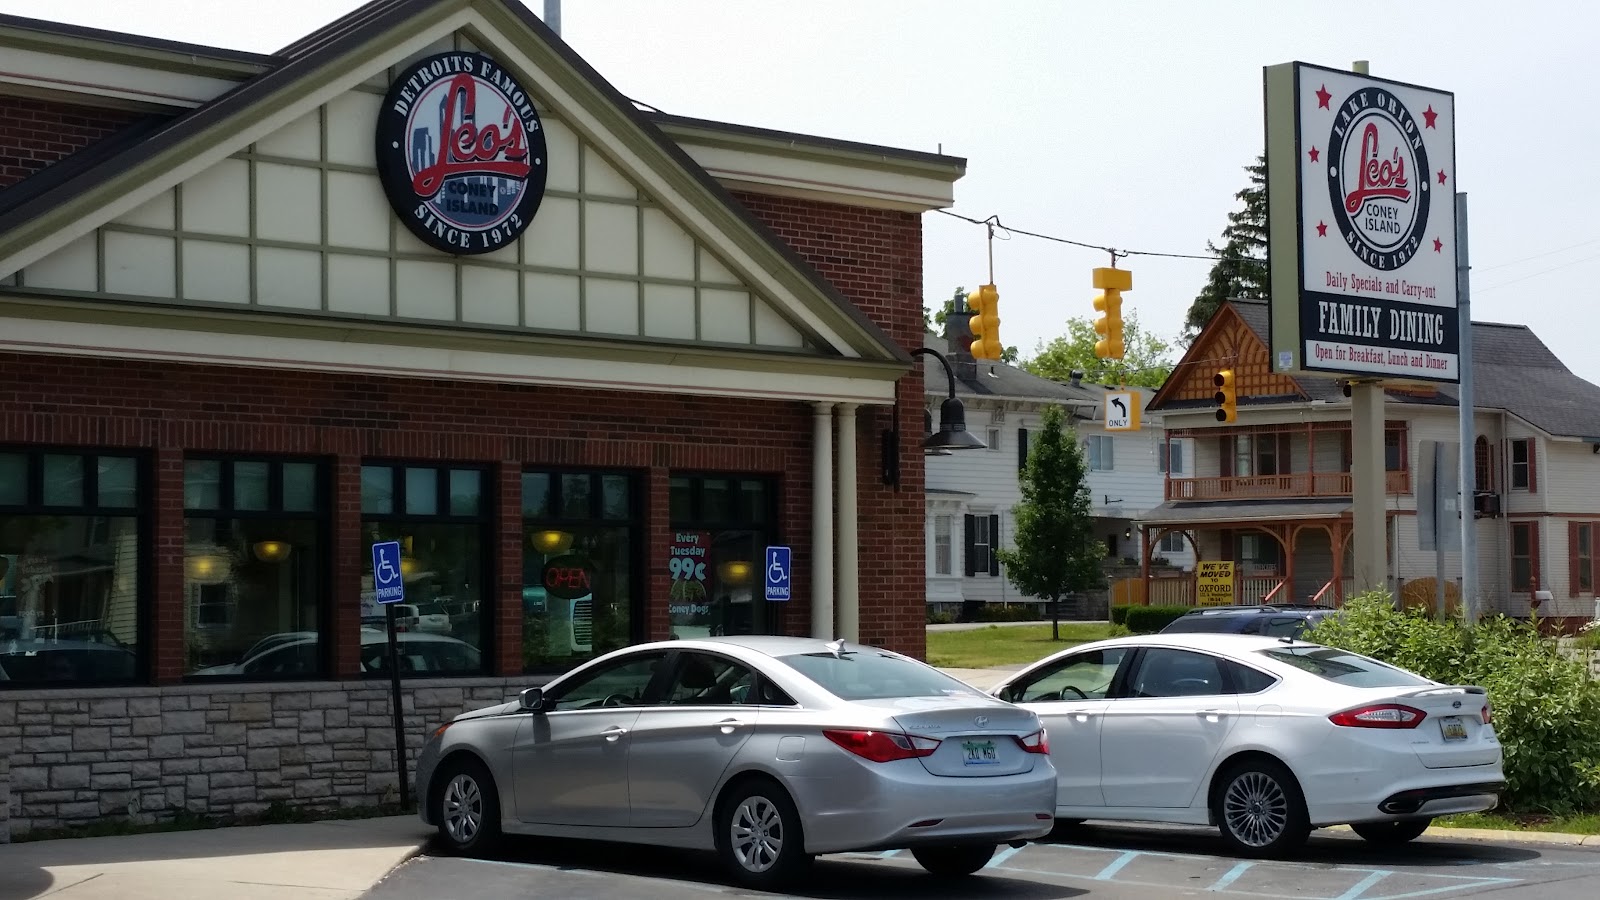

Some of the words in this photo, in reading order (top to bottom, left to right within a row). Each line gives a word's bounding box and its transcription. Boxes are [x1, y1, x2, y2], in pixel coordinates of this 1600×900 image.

[394, 56, 474, 117] DETROITS
[480, 61, 539, 133] FAMOUS
[1334, 92, 1369, 139] LAKE
[1377, 93, 1422, 150] ORION
[413, 73, 532, 197] Leo's
[1346, 122, 1411, 214] Leo's
[450, 182, 496, 197] CONEY
[447, 200, 499, 216] ISLAND
[1366, 203, 1399, 219] CONEY
[414, 204, 470, 248] SINCE
[482, 213, 523, 247] 1972
[1365, 217, 1400, 234] ISLAND
[1347, 231, 1385, 269] SINCE
[1393, 236, 1418, 268] 1972
[1326, 271, 1347, 292] Daily
[1351, 273, 1382, 293] Specials
[1385, 279, 1399, 294] and
[1401, 280, 1436, 300] Carry-out
[1318, 301, 1382, 338] FAMILY
[1389, 309, 1444, 345] DINING
[1315, 343, 1333, 361] Open
[1335, 347, 1346, 361] for
[1349, 347, 1386, 367] Breakfast,
[1387, 350, 1408, 366] Lunch
[1410, 353, 1423, 368] and
[1425, 354, 1448, 370] Dinner
[1108, 419, 1127, 427] ONLY
[676, 533, 699, 544] Every
[670, 546, 706, 558] Tuesday
[546, 567, 592, 589] OPEN
[669, 557, 706, 581] 99¢
[378, 586, 402, 599] PARKING
[767, 586, 789, 596] PARKING
[691, 604, 709, 615] Dogs
